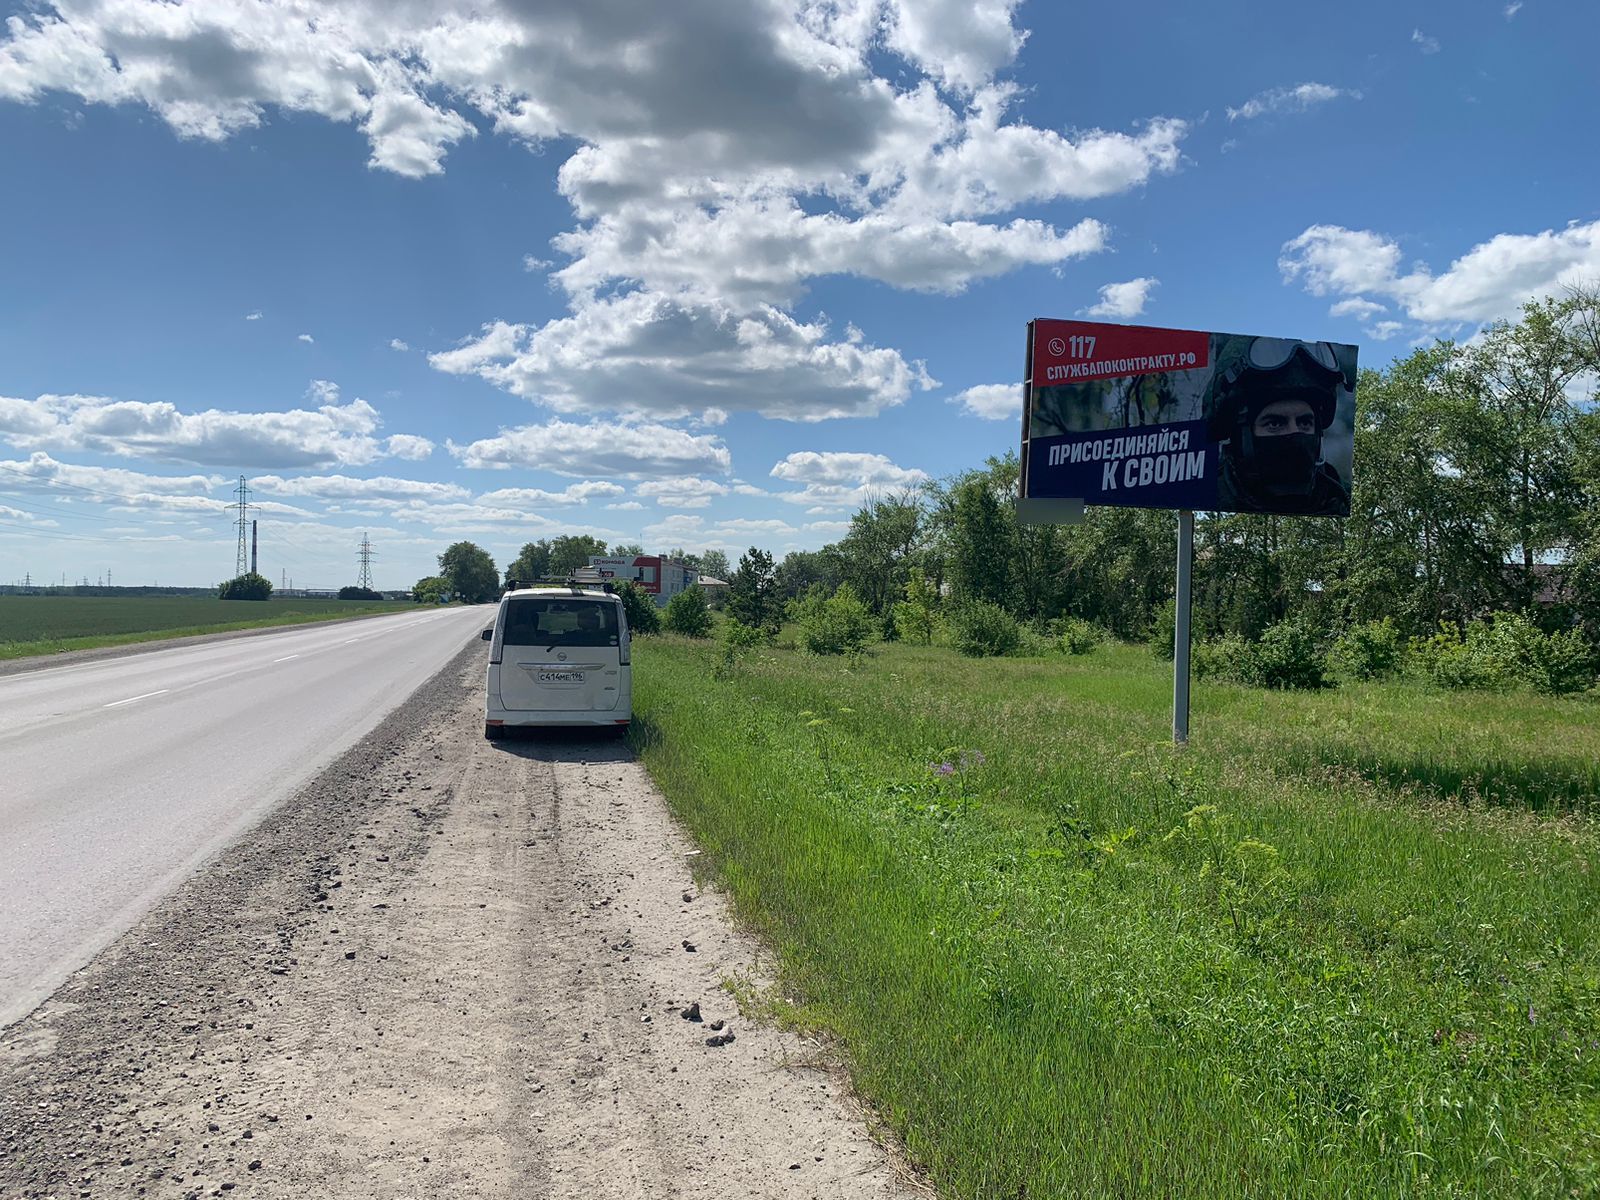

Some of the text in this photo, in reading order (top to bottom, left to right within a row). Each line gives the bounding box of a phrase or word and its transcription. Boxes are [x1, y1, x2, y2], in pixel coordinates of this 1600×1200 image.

[1069, 335, 1096, 359] 117
[1046, 352, 1196, 380] СЛУЖБАПОКОНТРАКТУ.РФ
[1049, 428, 1190, 466] ПРИСОЕДИНЯЙСЯ
[1101, 450, 1206, 491] К СВОИМ
